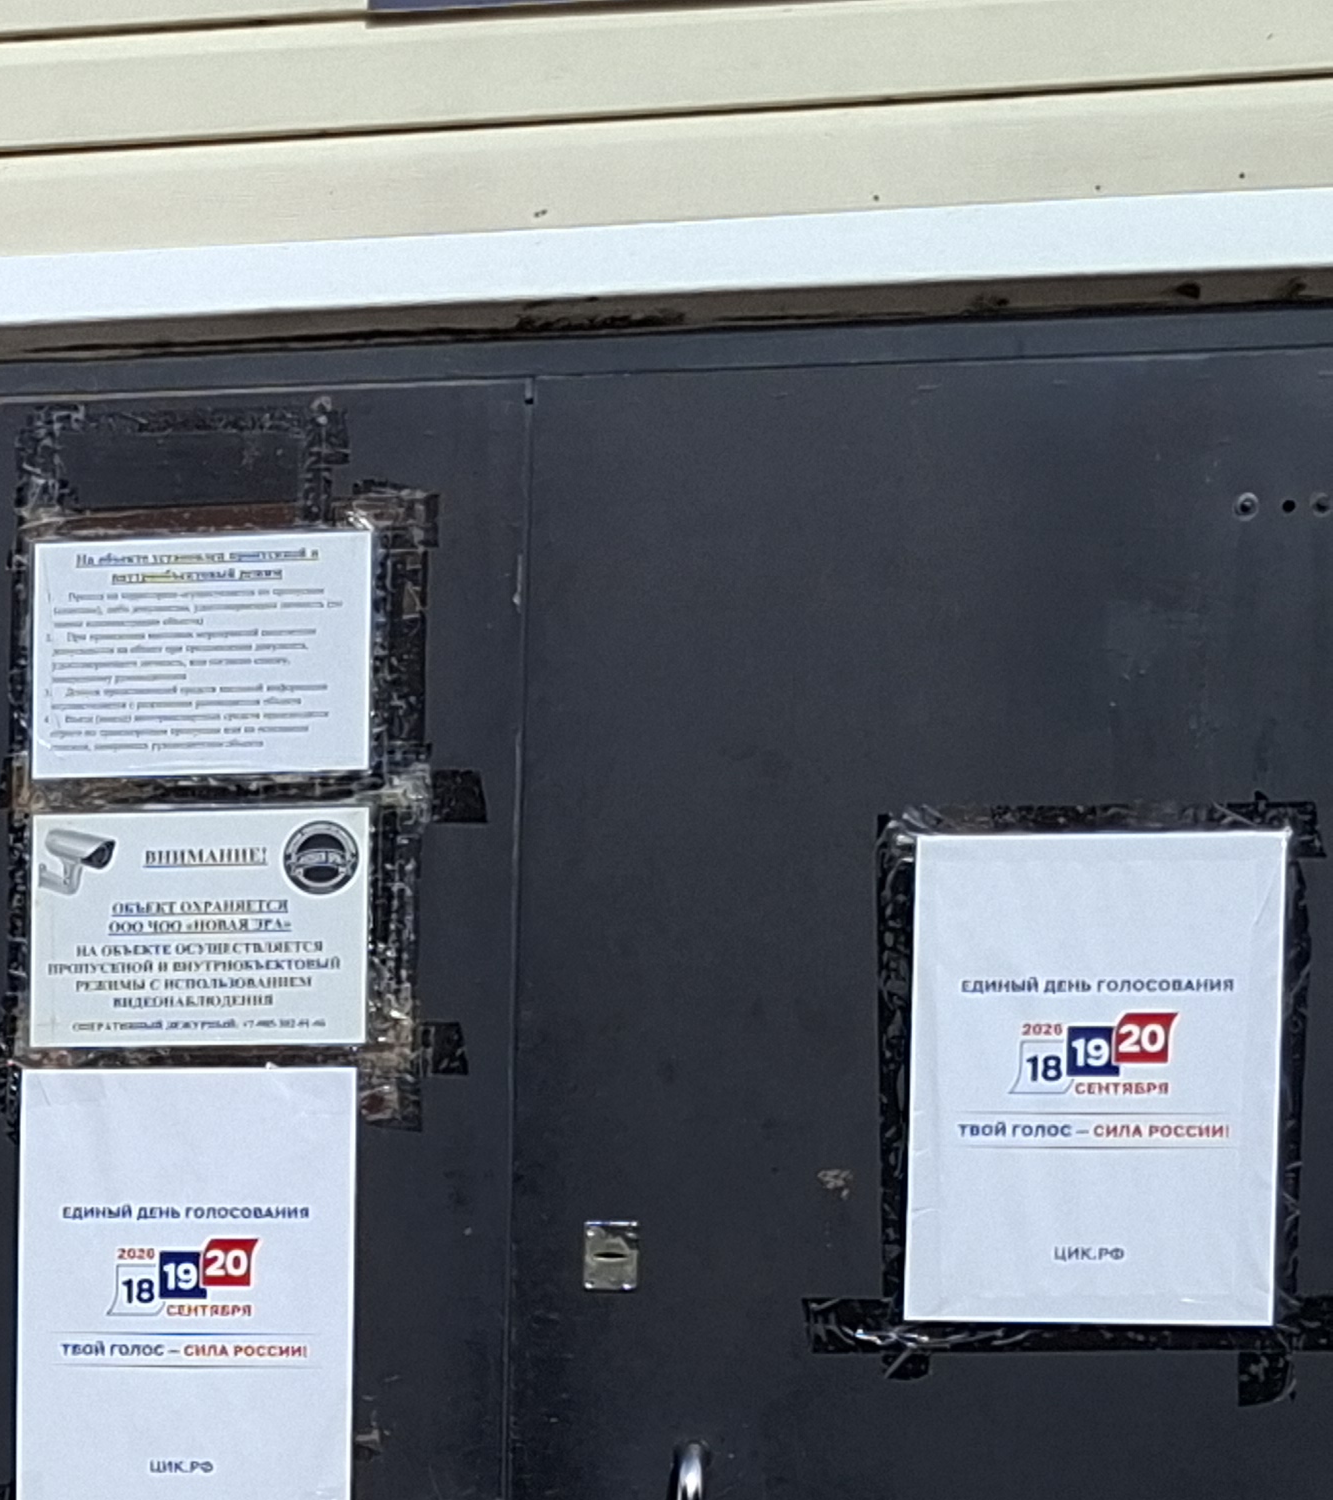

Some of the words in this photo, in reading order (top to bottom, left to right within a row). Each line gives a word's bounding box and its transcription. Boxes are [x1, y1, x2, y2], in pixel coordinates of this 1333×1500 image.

[76, 553, 94, 566] На
[112, 902, 176, 916] ОБЪЕКТ
[180, 899, 289, 914] ОХРАНЯЕТСЯ
[108, 920, 144, 934] ООО
[147, 920, 183, 933] ЧОО
[76, 945, 98, 958] НА
[101, 944, 172, 957] ОБЪЕКТЕ
[175, 940, 324, 956] ОСУЩЕСТВЛЯЕТСЯ
[48, 959, 154, 976] ПРОПУСКНОЙ
[173, 955, 341, 973] ВНУТРИОБЪЕКТОВЫЙ
[75, 980, 146, 992] РЕЖИМЫ
[150, 979, 161, 991] С
[164, 976, 313, 991] ИСПОЛЬЗОВАНИЕМ
[961, 977, 1040, 994] ЕДИНЫЙ
[1044, 980, 1091, 994] ДЕНЬ
[1097, 978, 1235, 992] ГОЛОСОВАНИЯ
[112, 994, 274, 1010] ВИДЕОНАБЛЮДЕНИЯ
[1026, 1055, 1064, 1082] 18
[1071, 1038, 1110, 1066] 19
[1118, 1023, 1166, 1054] 20
[1075, 1082, 1170, 1096] СЕНТЯБРЯ
[958, 1121, 1007, 1138] ТВОЙ
[1013, 1124, 1072, 1138] ГОЛОС
[1093, 1124, 1143, 1138] СИЛА
[1149, 1124, 1230, 1138] РОССИИ!
[62, 1204, 132, 1220] ЕДИНЫЙ
[136, 1206, 181, 1221] ДЕНЬ
[185, 1206, 310, 1219] ГОЛОСОВАНИЯ
[1054, 1246, 1125, 1262] ЦИК.РФ
[122, 1278, 155, 1303] 18
[162, 1263, 197, 1290] 19
[205, 1250, 248, 1276] 20
[166, 1304, 252, 1317] СЕНТЯБРЯ
[62, 1341, 104, 1356] ТВОЙ
[110, 1344, 164, 1356] ГОЛОС
[184, 1345, 228, 1357] СИЛА
[234, 1345, 308, 1358] РОССИИ!
